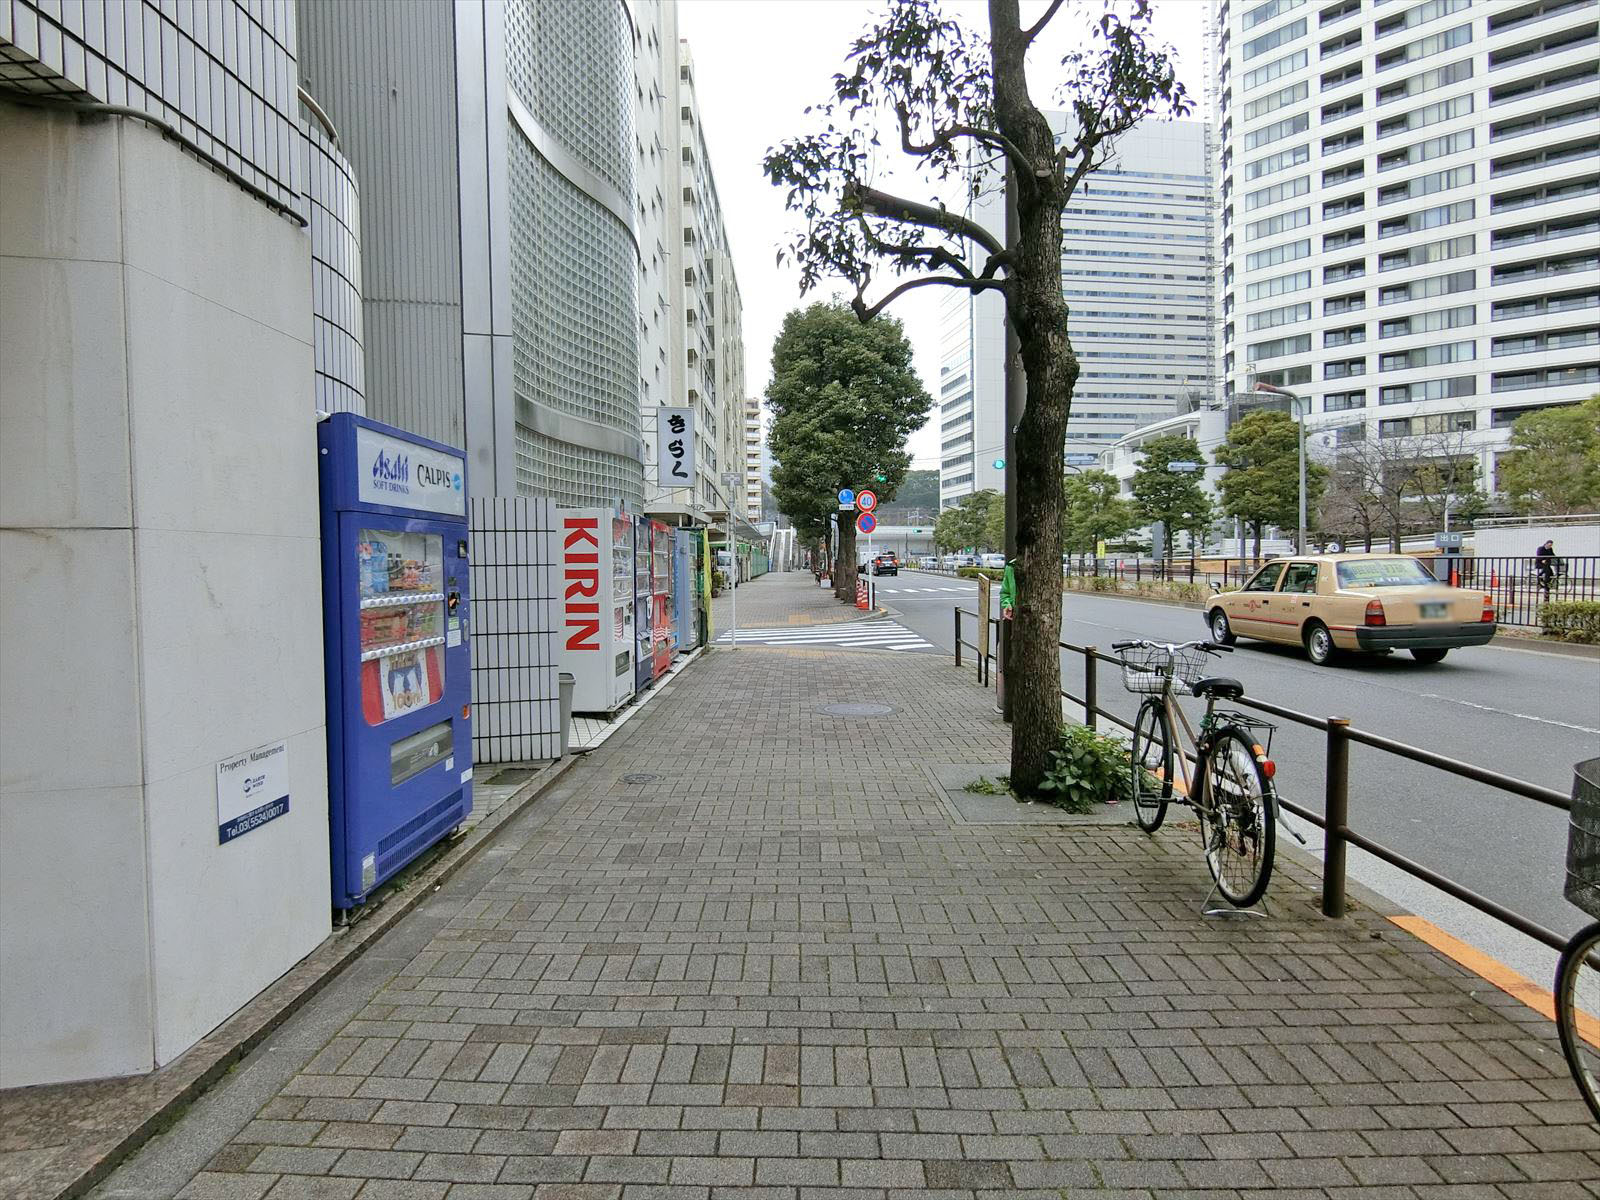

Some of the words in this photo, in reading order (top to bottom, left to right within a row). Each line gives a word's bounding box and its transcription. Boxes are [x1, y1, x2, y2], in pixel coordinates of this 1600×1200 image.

[667, 414, 689, 479] きらく
[372, 448, 409, 483] Asahi
[417, 464, 451, 488] CALPIS
[373, 479, 389, 491] SOFT
[389, 481, 409, 495] DRINKS
[861, 496, 872, 506] 40
[1440, 534, 1459, 542] 出口
[563, 517, 600, 651] KIRIN
[220, 757, 247, 774] Property
[250, 745, 285, 762] Management
